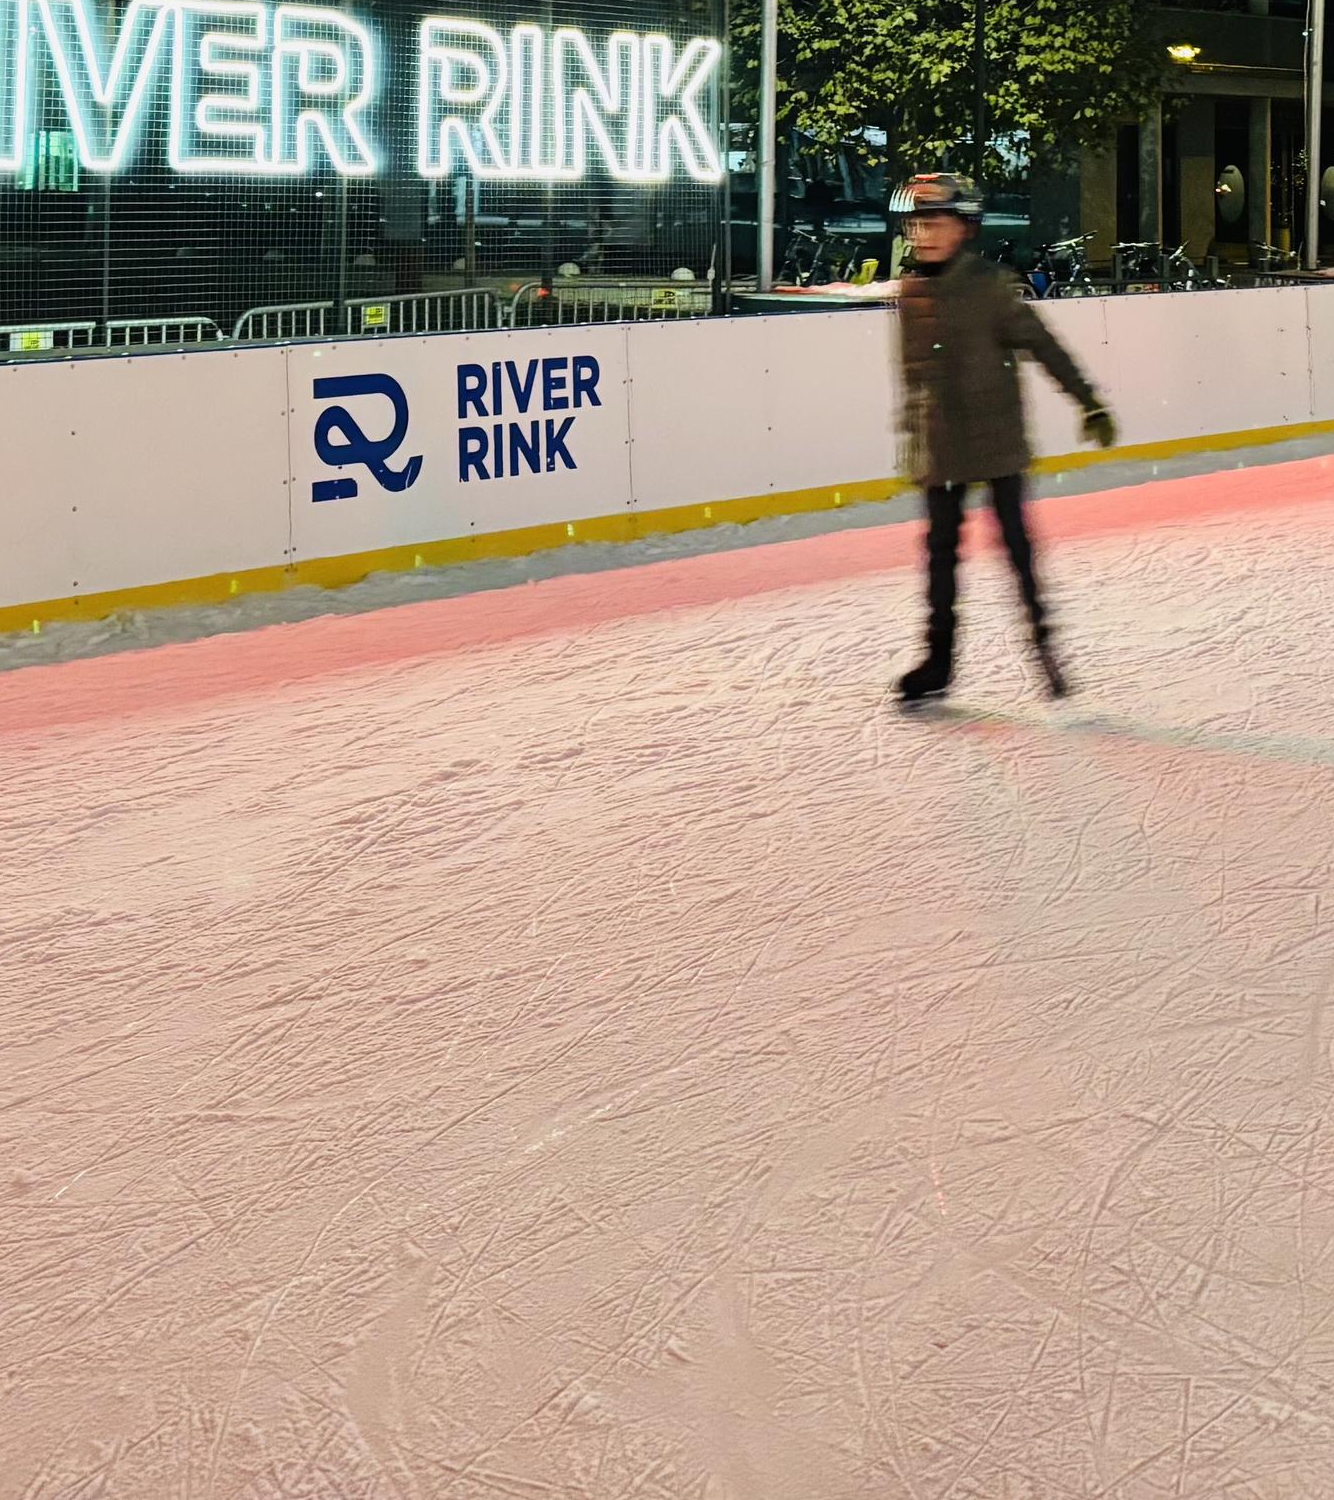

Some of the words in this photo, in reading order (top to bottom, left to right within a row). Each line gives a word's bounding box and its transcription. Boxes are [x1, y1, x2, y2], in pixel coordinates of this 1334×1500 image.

[418, 15, 723, 183] RINK
[457, 355, 602, 419] RIVER
[458, 416, 578, 483] RINK
